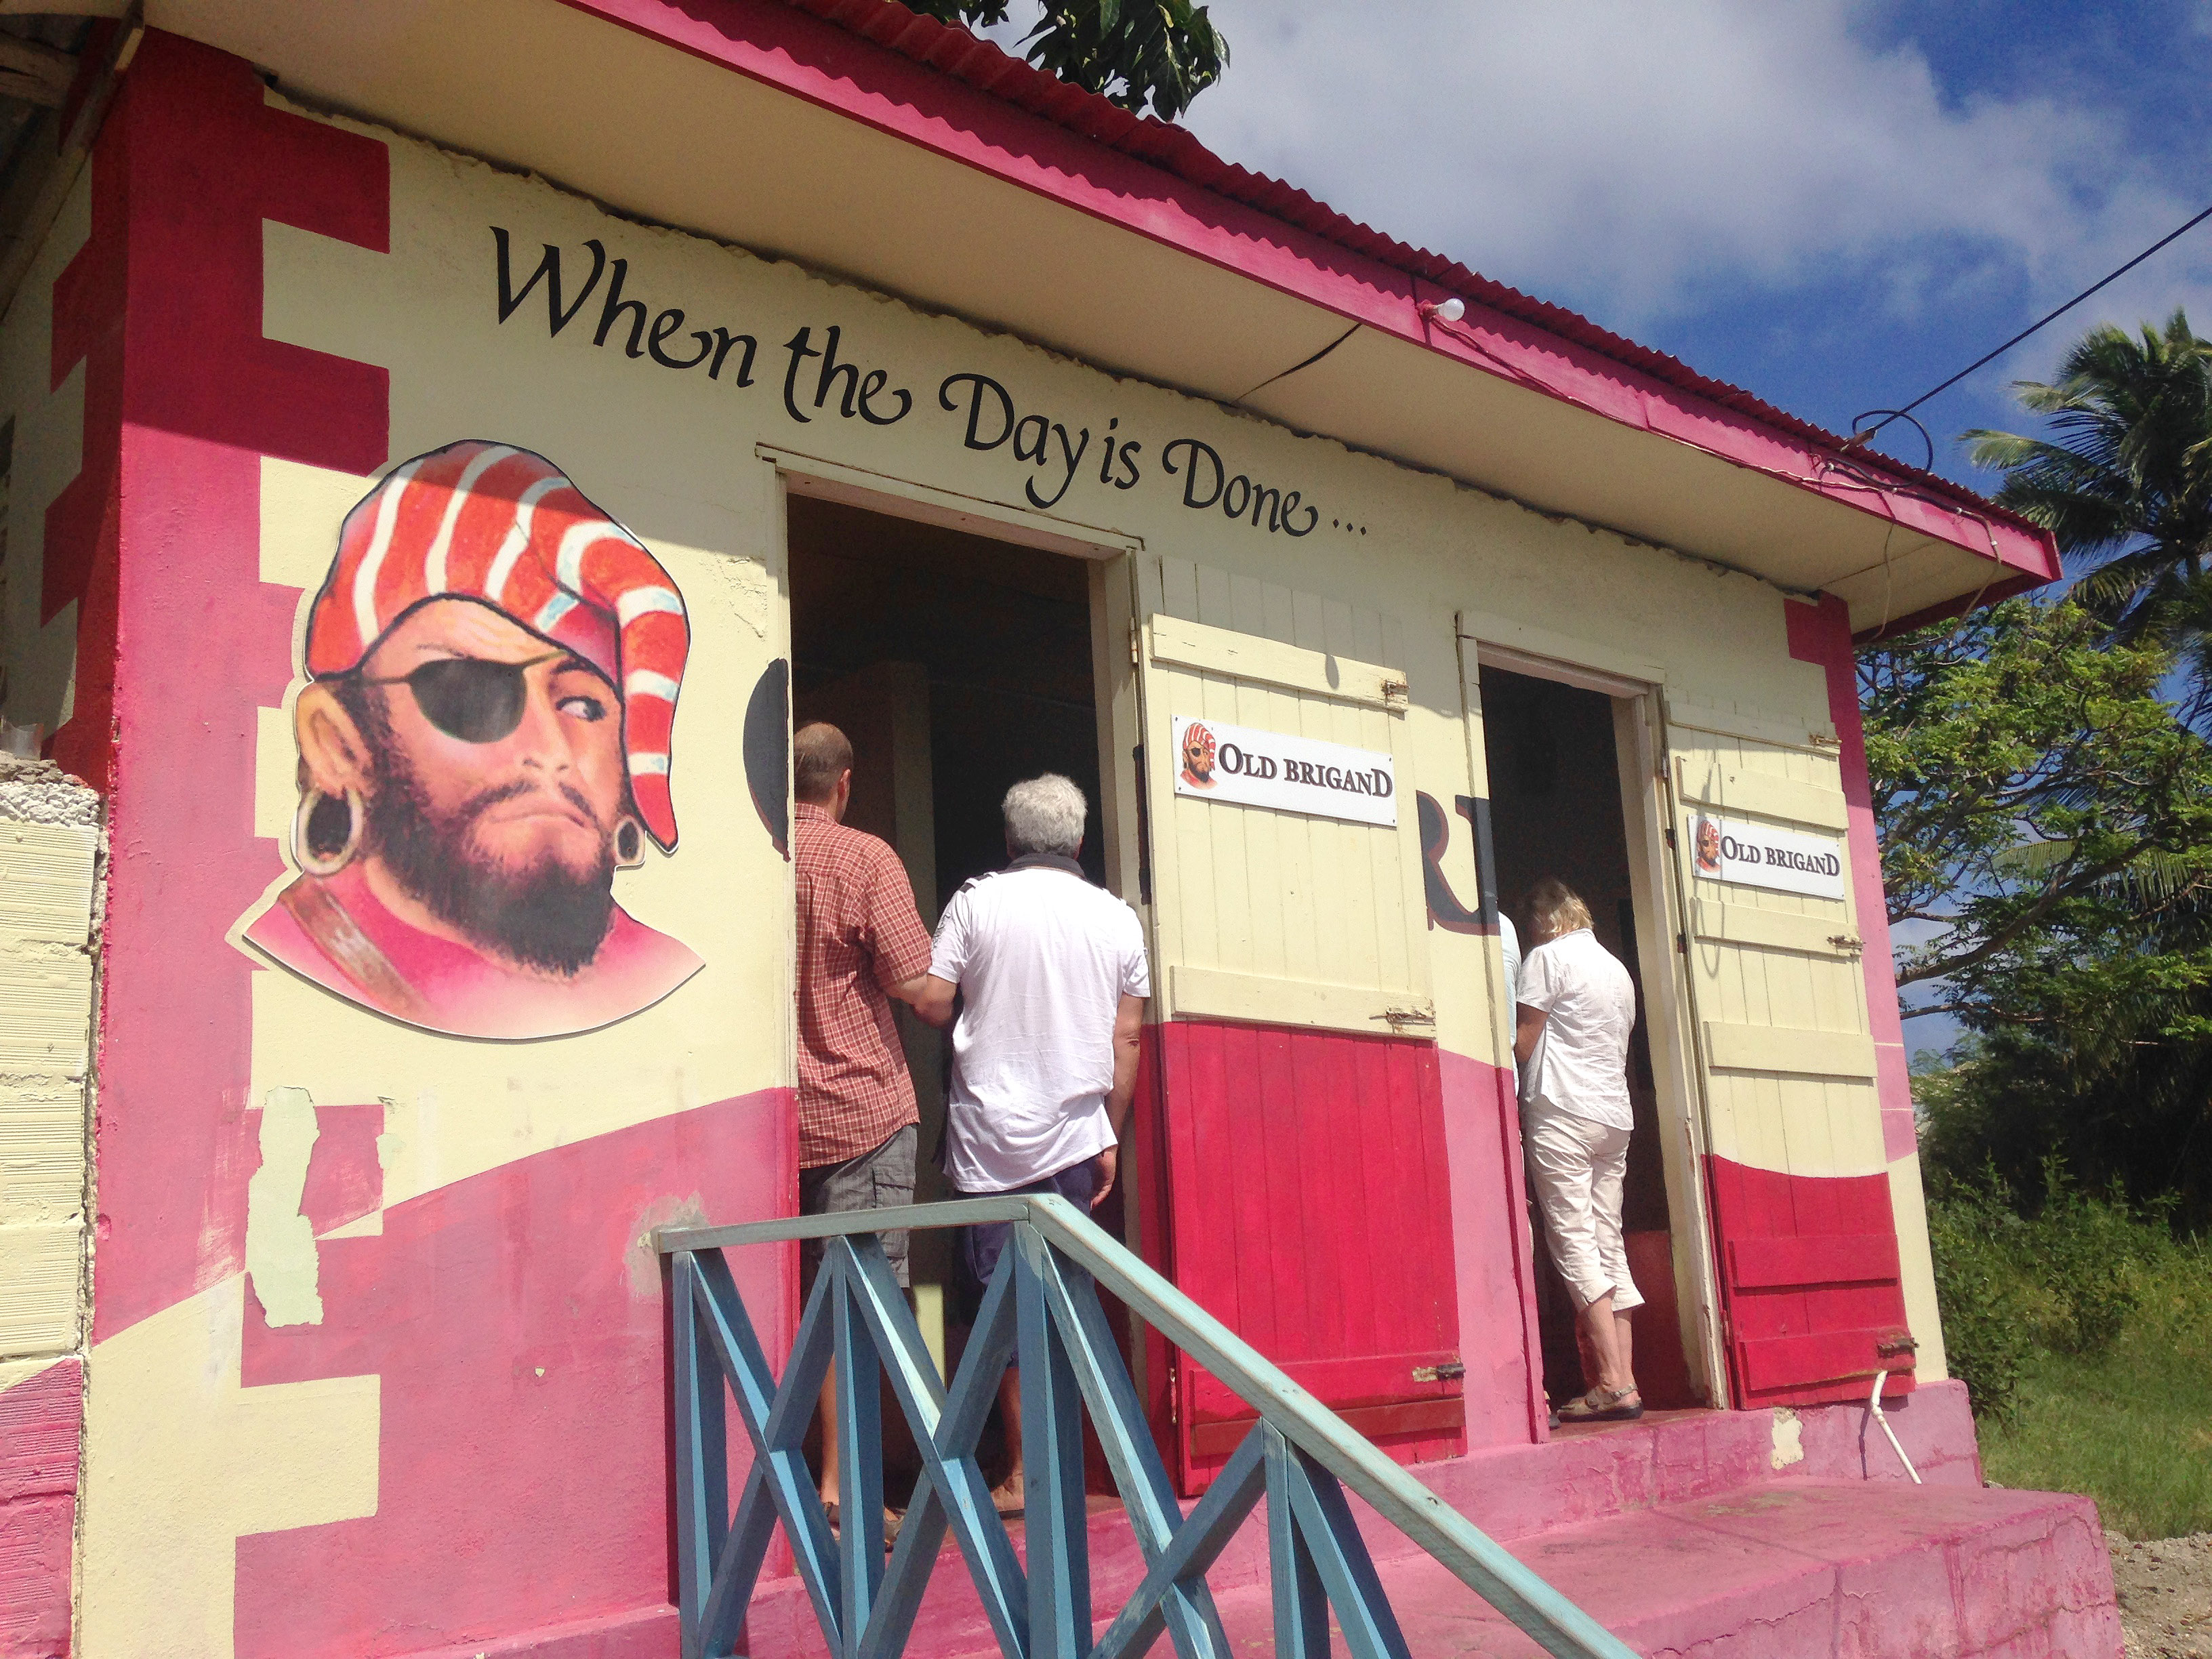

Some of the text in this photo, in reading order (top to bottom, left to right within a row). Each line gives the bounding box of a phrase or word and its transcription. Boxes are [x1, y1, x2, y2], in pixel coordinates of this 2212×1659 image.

[489, 226, 758, 388] When
[783, 325, 912, 425] the
[939, 373, 1089, 509] Day
[1100, 417, 1141, 490] is
